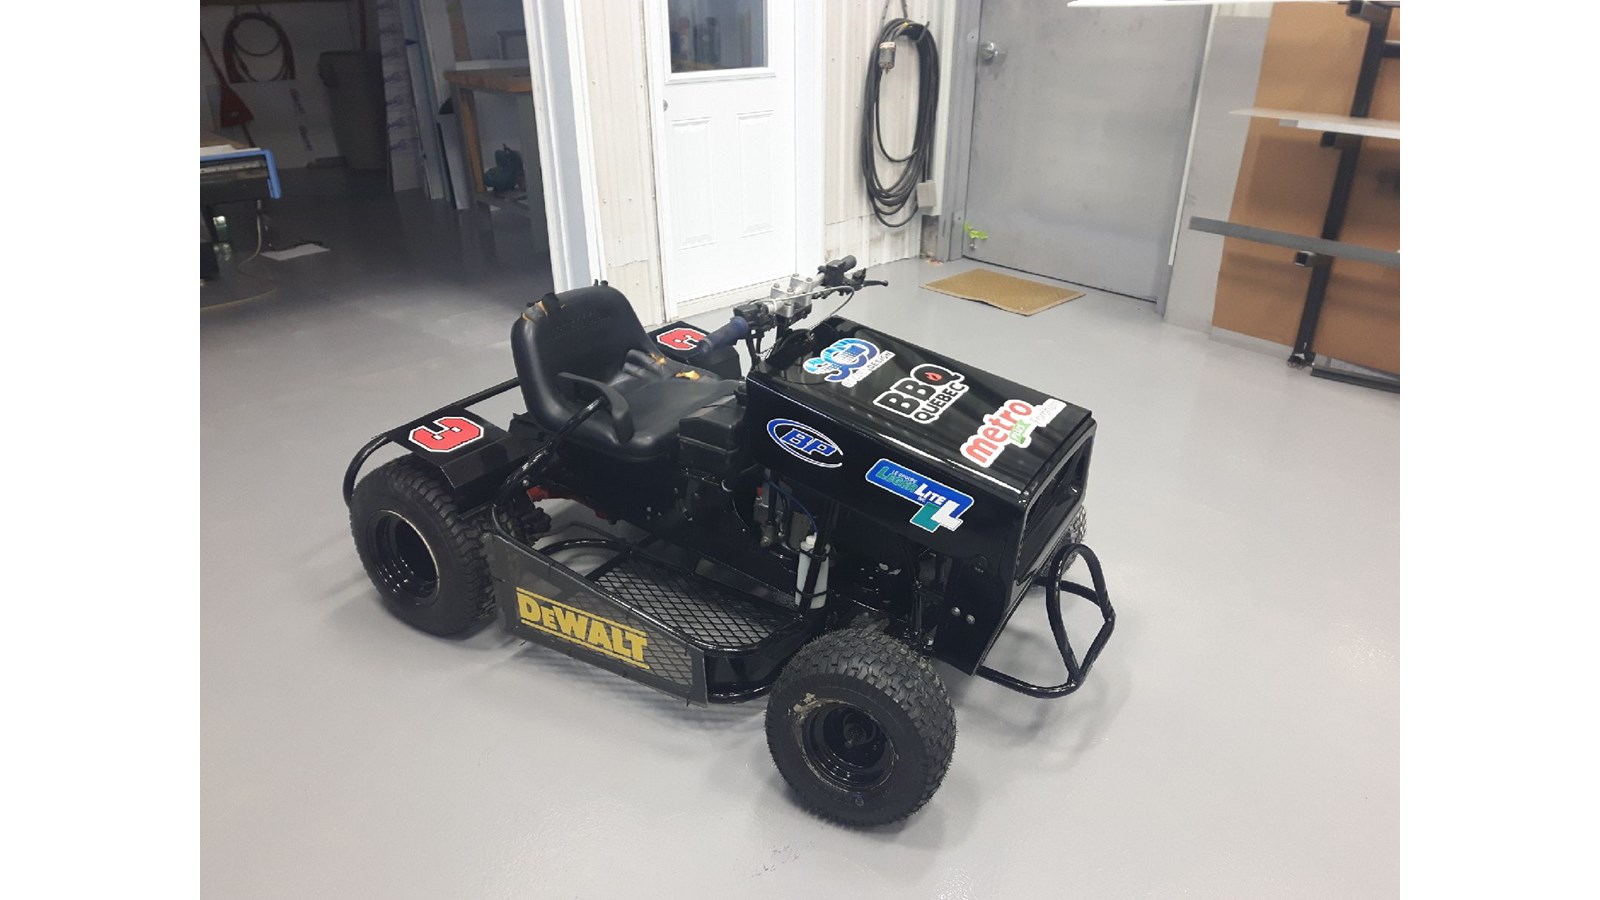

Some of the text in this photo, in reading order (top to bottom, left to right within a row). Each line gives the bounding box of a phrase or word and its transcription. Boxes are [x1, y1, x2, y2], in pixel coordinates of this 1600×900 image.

[876, 365, 961, 416] BBQ
[914, 382, 965, 421] QUEBEC
[408, 416, 485, 453] 3
[780, 428, 838, 456] BP
[965, 402, 1033, 464] metro
